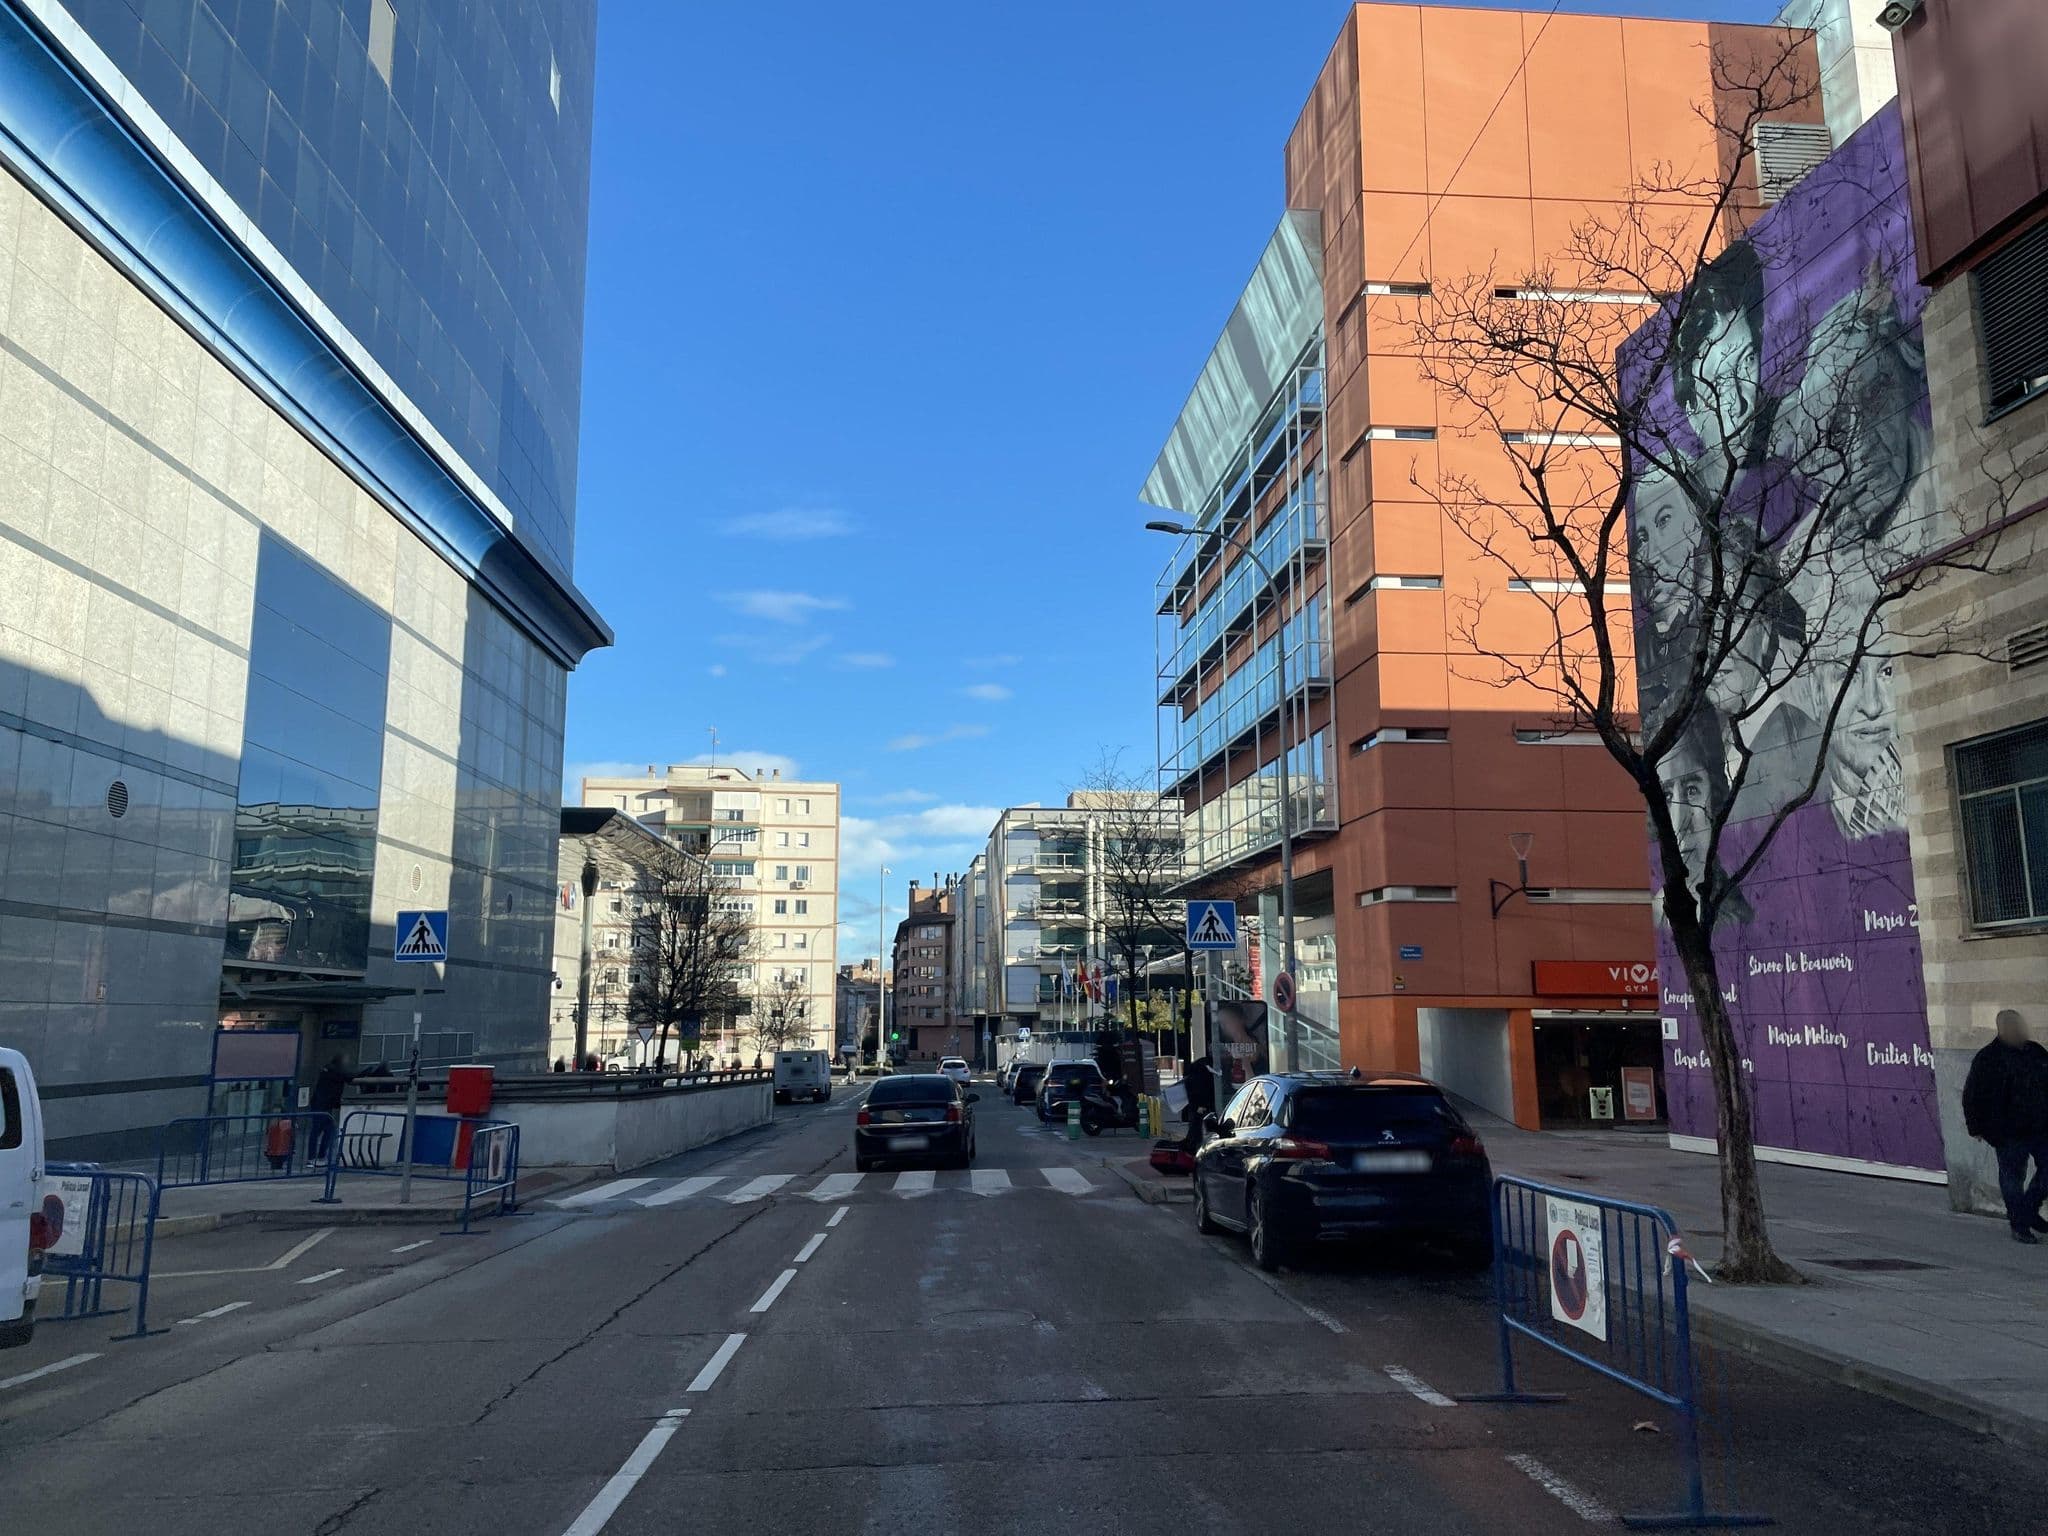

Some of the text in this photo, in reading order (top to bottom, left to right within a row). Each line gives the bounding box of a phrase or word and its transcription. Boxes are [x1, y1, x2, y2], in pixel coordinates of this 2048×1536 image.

[1608, 964, 1660, 983] VIVA
[1749, 951, 1854, 976] Simone De Beauvoir
[1625, 985, 1649, 993] GYM
[1804, 1024, 1849, 1049] Moliner
[1674, 1047, 1698, 1069] Clara
[1867, 1042, 1936, 1070] Emilia Par
